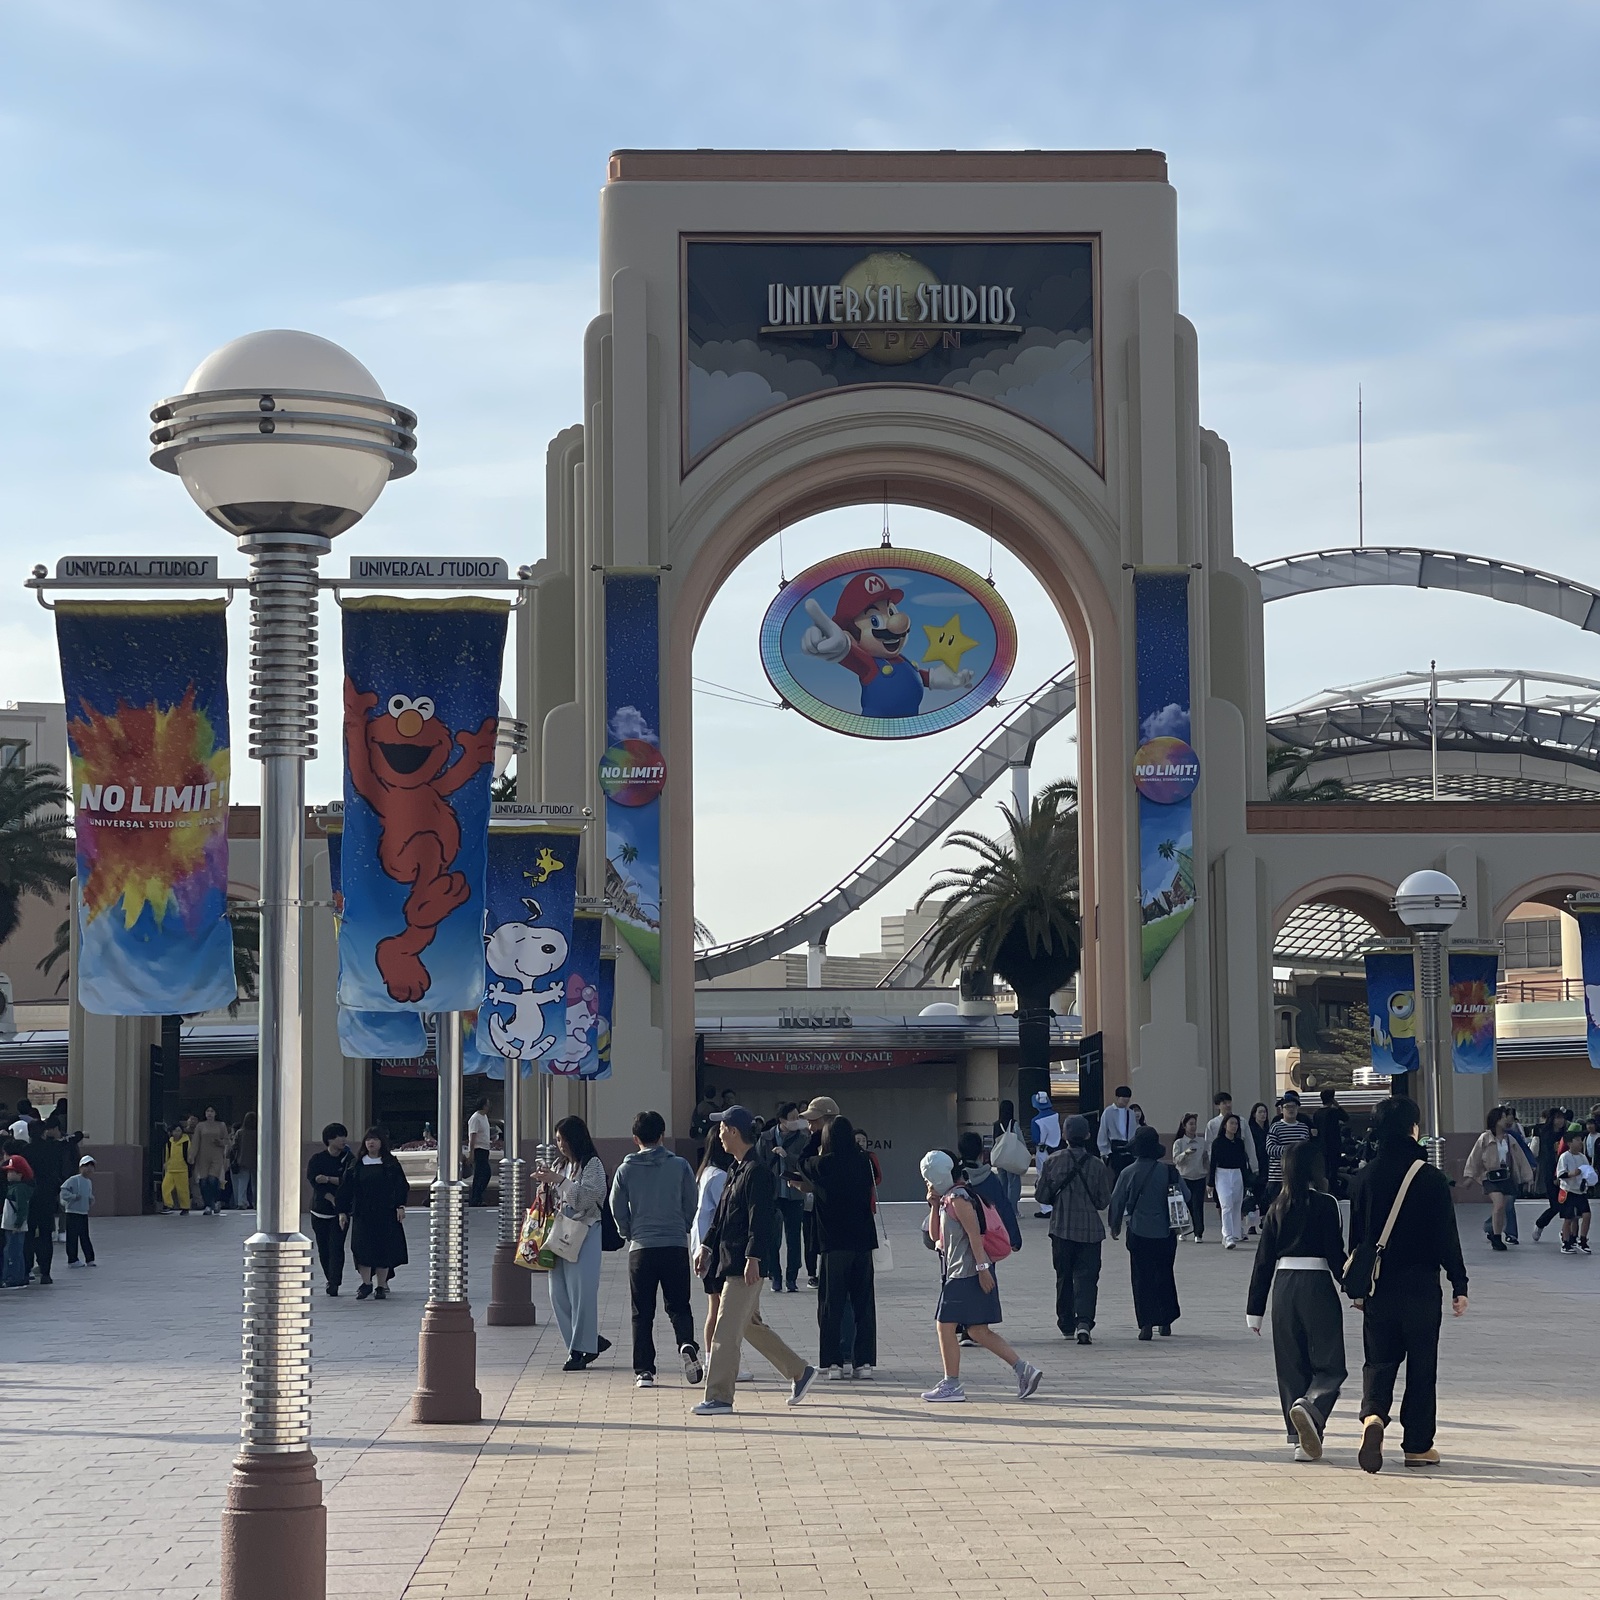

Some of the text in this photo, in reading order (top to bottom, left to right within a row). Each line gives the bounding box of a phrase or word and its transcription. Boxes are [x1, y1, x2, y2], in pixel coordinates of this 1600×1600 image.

[768, 282, 1017, 325] UNIVERSAL STUDIOS
[825, 330, 962, 350] JAPAN
[65, 561, 209, 577] UNIVERSAL STUDIOS
[359, 561, 500, 577] UNIVERSAL STUDIOS
[601, 766, 665, 779] NO LIMIT!
[1135, 764, 1198, 776] NO LIMIT!
[79, 780, 226, 813] NO LIMIT!
[494, 804, 575, 815] UNIVERSAL STUDIOS
[89, 818, 145, 828] UNIVERSAL
[148, 821, 193, 829] STUDIOS
[778, 1006, 853, 1029] TICKETS
[417, 1057, 437, 1067] PAS
[734, 1051, 894, 1063] ANNUAL PASS NOW ON SALE
